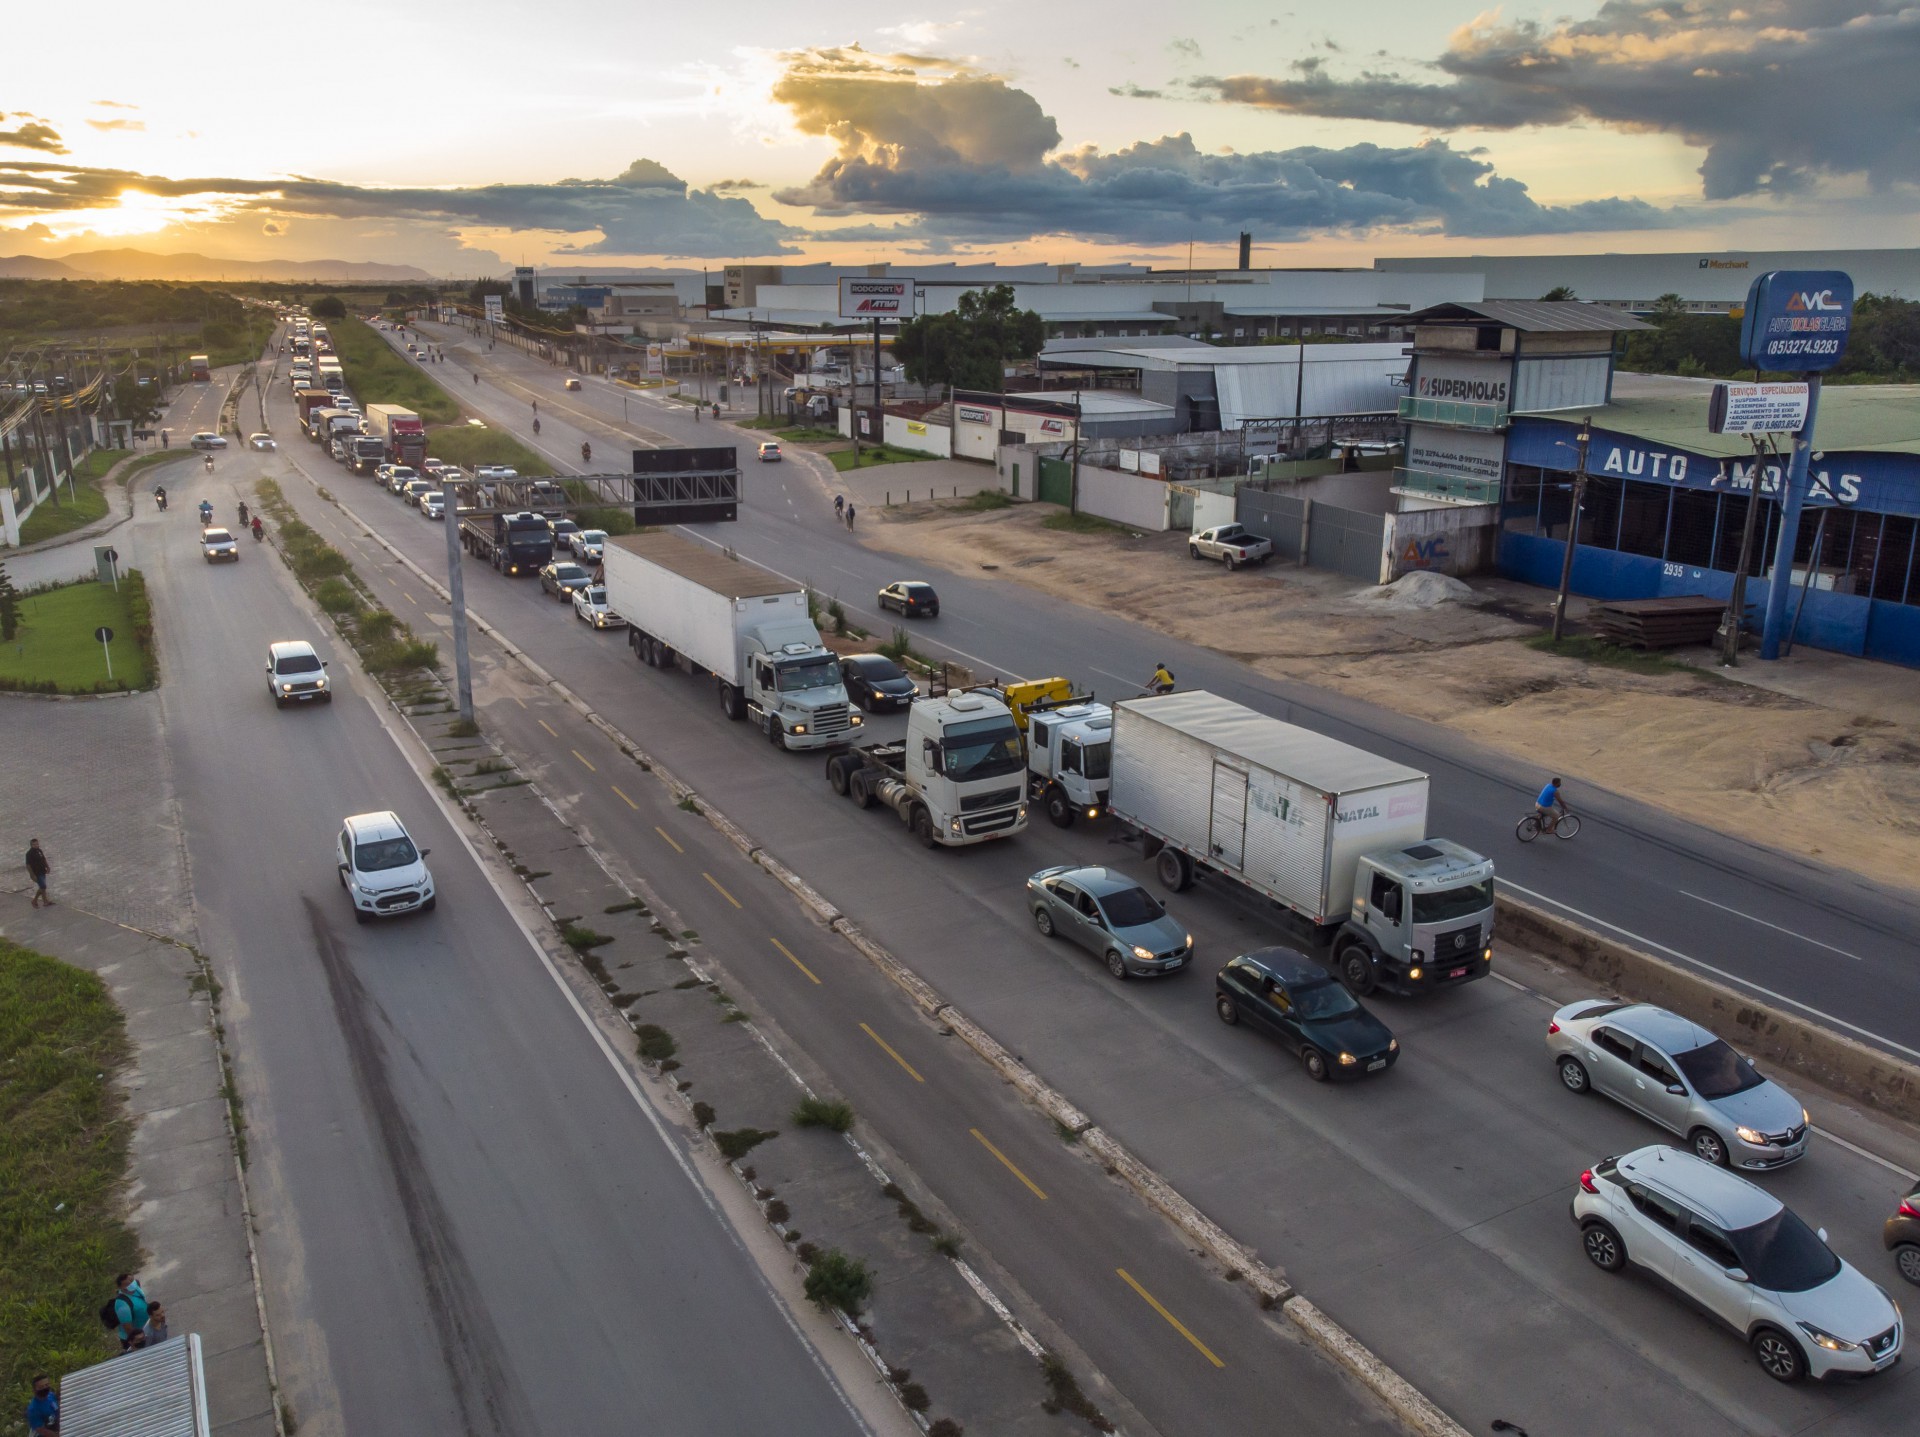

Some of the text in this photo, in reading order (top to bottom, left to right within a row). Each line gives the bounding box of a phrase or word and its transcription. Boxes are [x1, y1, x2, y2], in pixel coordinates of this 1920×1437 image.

[1709, 260, 1749, 269] Merchant
[852, 285, 894, 293] RODOFORT
[872, 300, 898, 308] ATIVA
[1786, 289, 1843, 311] AMC
[1767, 339, 1839, 355] (85)3274.9283
[1431, 378, 1506, 402] SUPERMOLAS
[1730, 385, 1808, 397] SERVIÇOS ESPECIALIZADOS
[1412, 447, 1424, 457] (85)
[1412, 457, 1499, 477] www.supermolas.com.br
[1603, 447, 1862, 502] AUTO MOAS
[1663, 563, 1684, 578] 2935
[1338, 806, 1380, 824] NATAL
